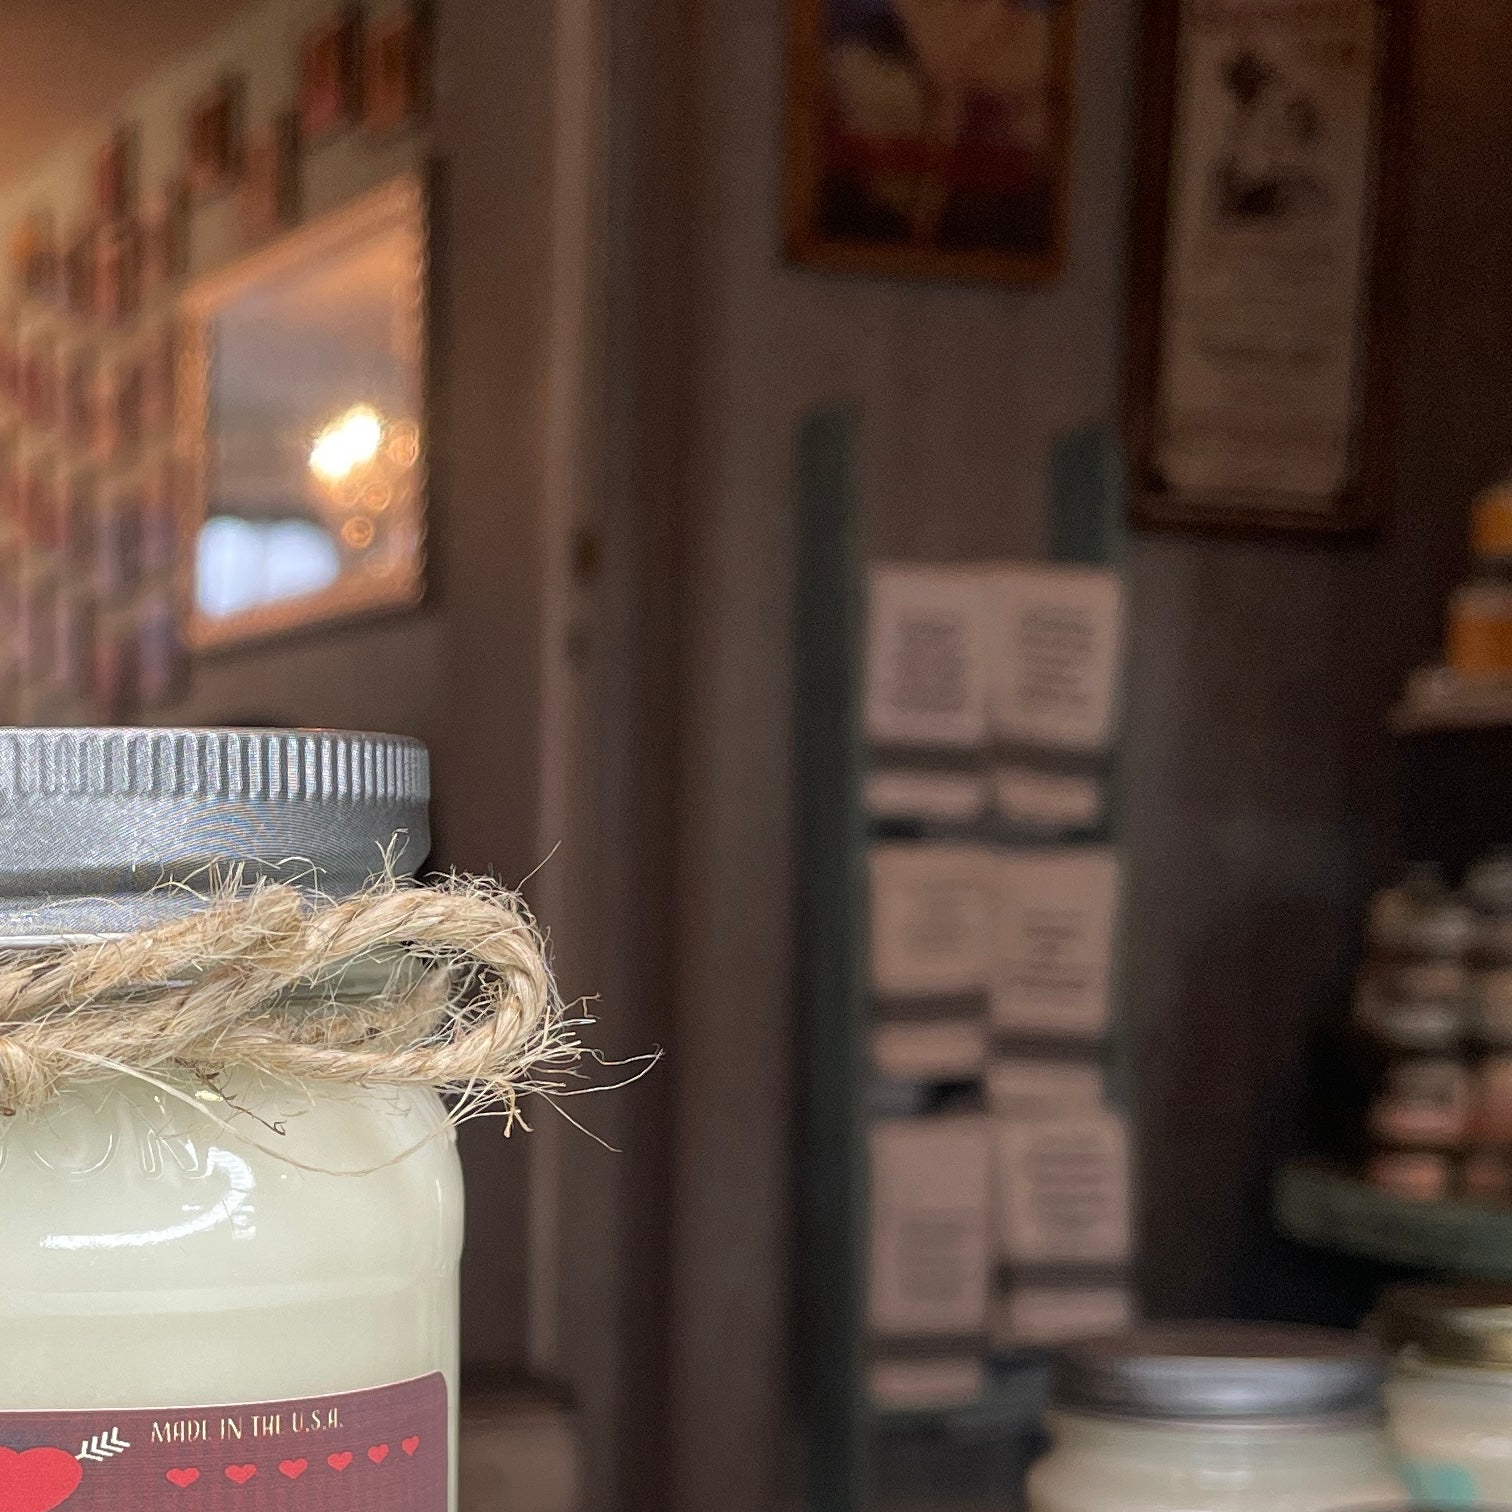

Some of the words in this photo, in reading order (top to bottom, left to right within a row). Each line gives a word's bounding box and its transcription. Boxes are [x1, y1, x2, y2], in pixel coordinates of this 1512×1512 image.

[151, 1419, 212, 1443] MADE
[220, 1416, 243, 1441] IN
[251, 1413, 283, 1438] THE
[291, 1407, 345, 1433] U.S.A.
